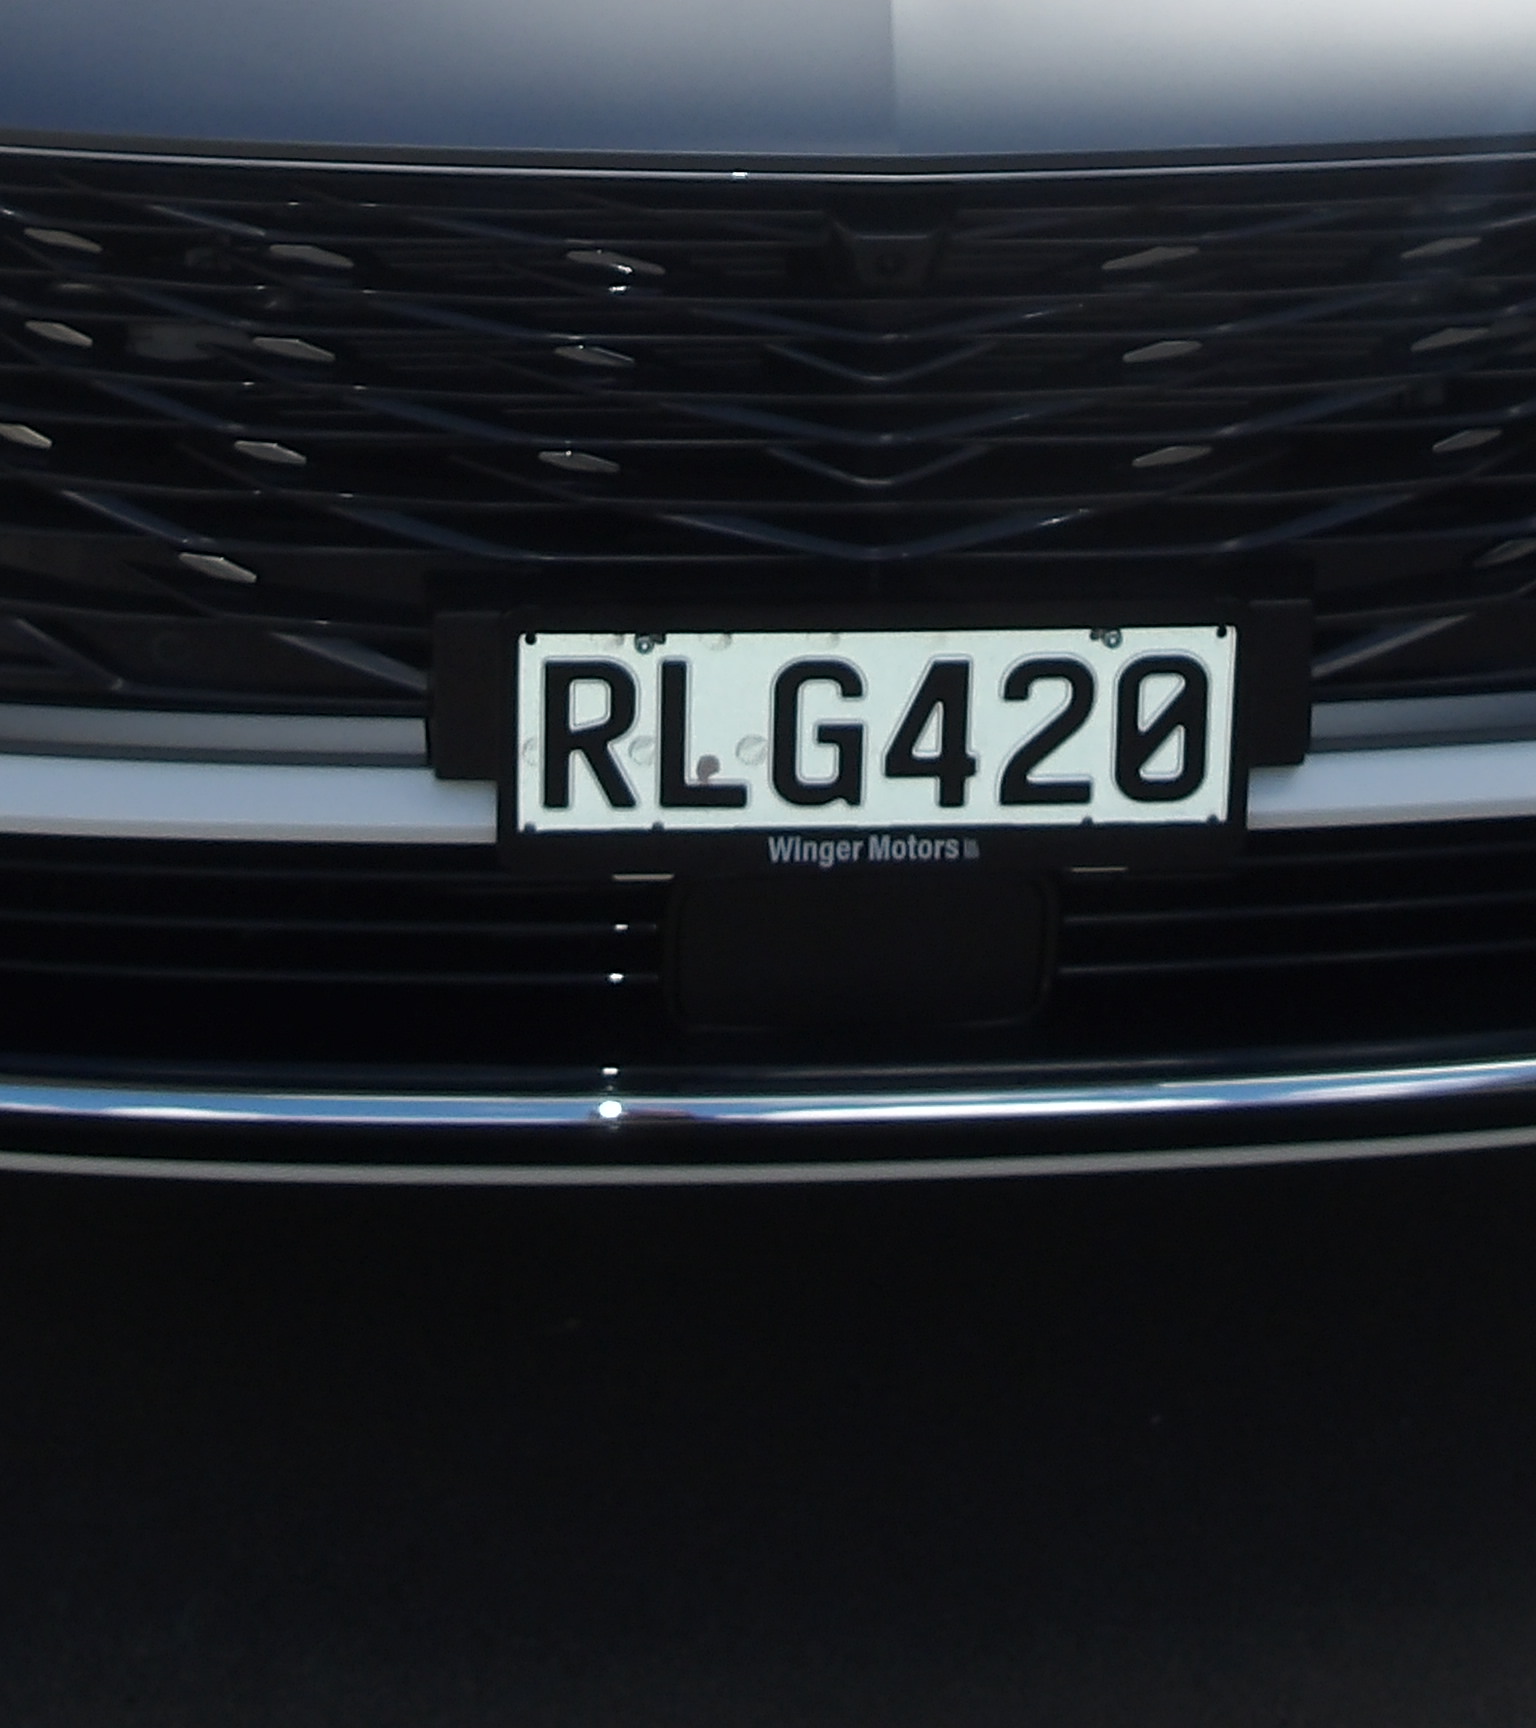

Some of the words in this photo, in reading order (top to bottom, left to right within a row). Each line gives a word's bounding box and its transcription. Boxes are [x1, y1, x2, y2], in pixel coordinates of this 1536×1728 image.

[542, 652, 1210, 811] RLG420
[767, 834, 864, 869] Winger
[868, 833, 960, 861] Motors
